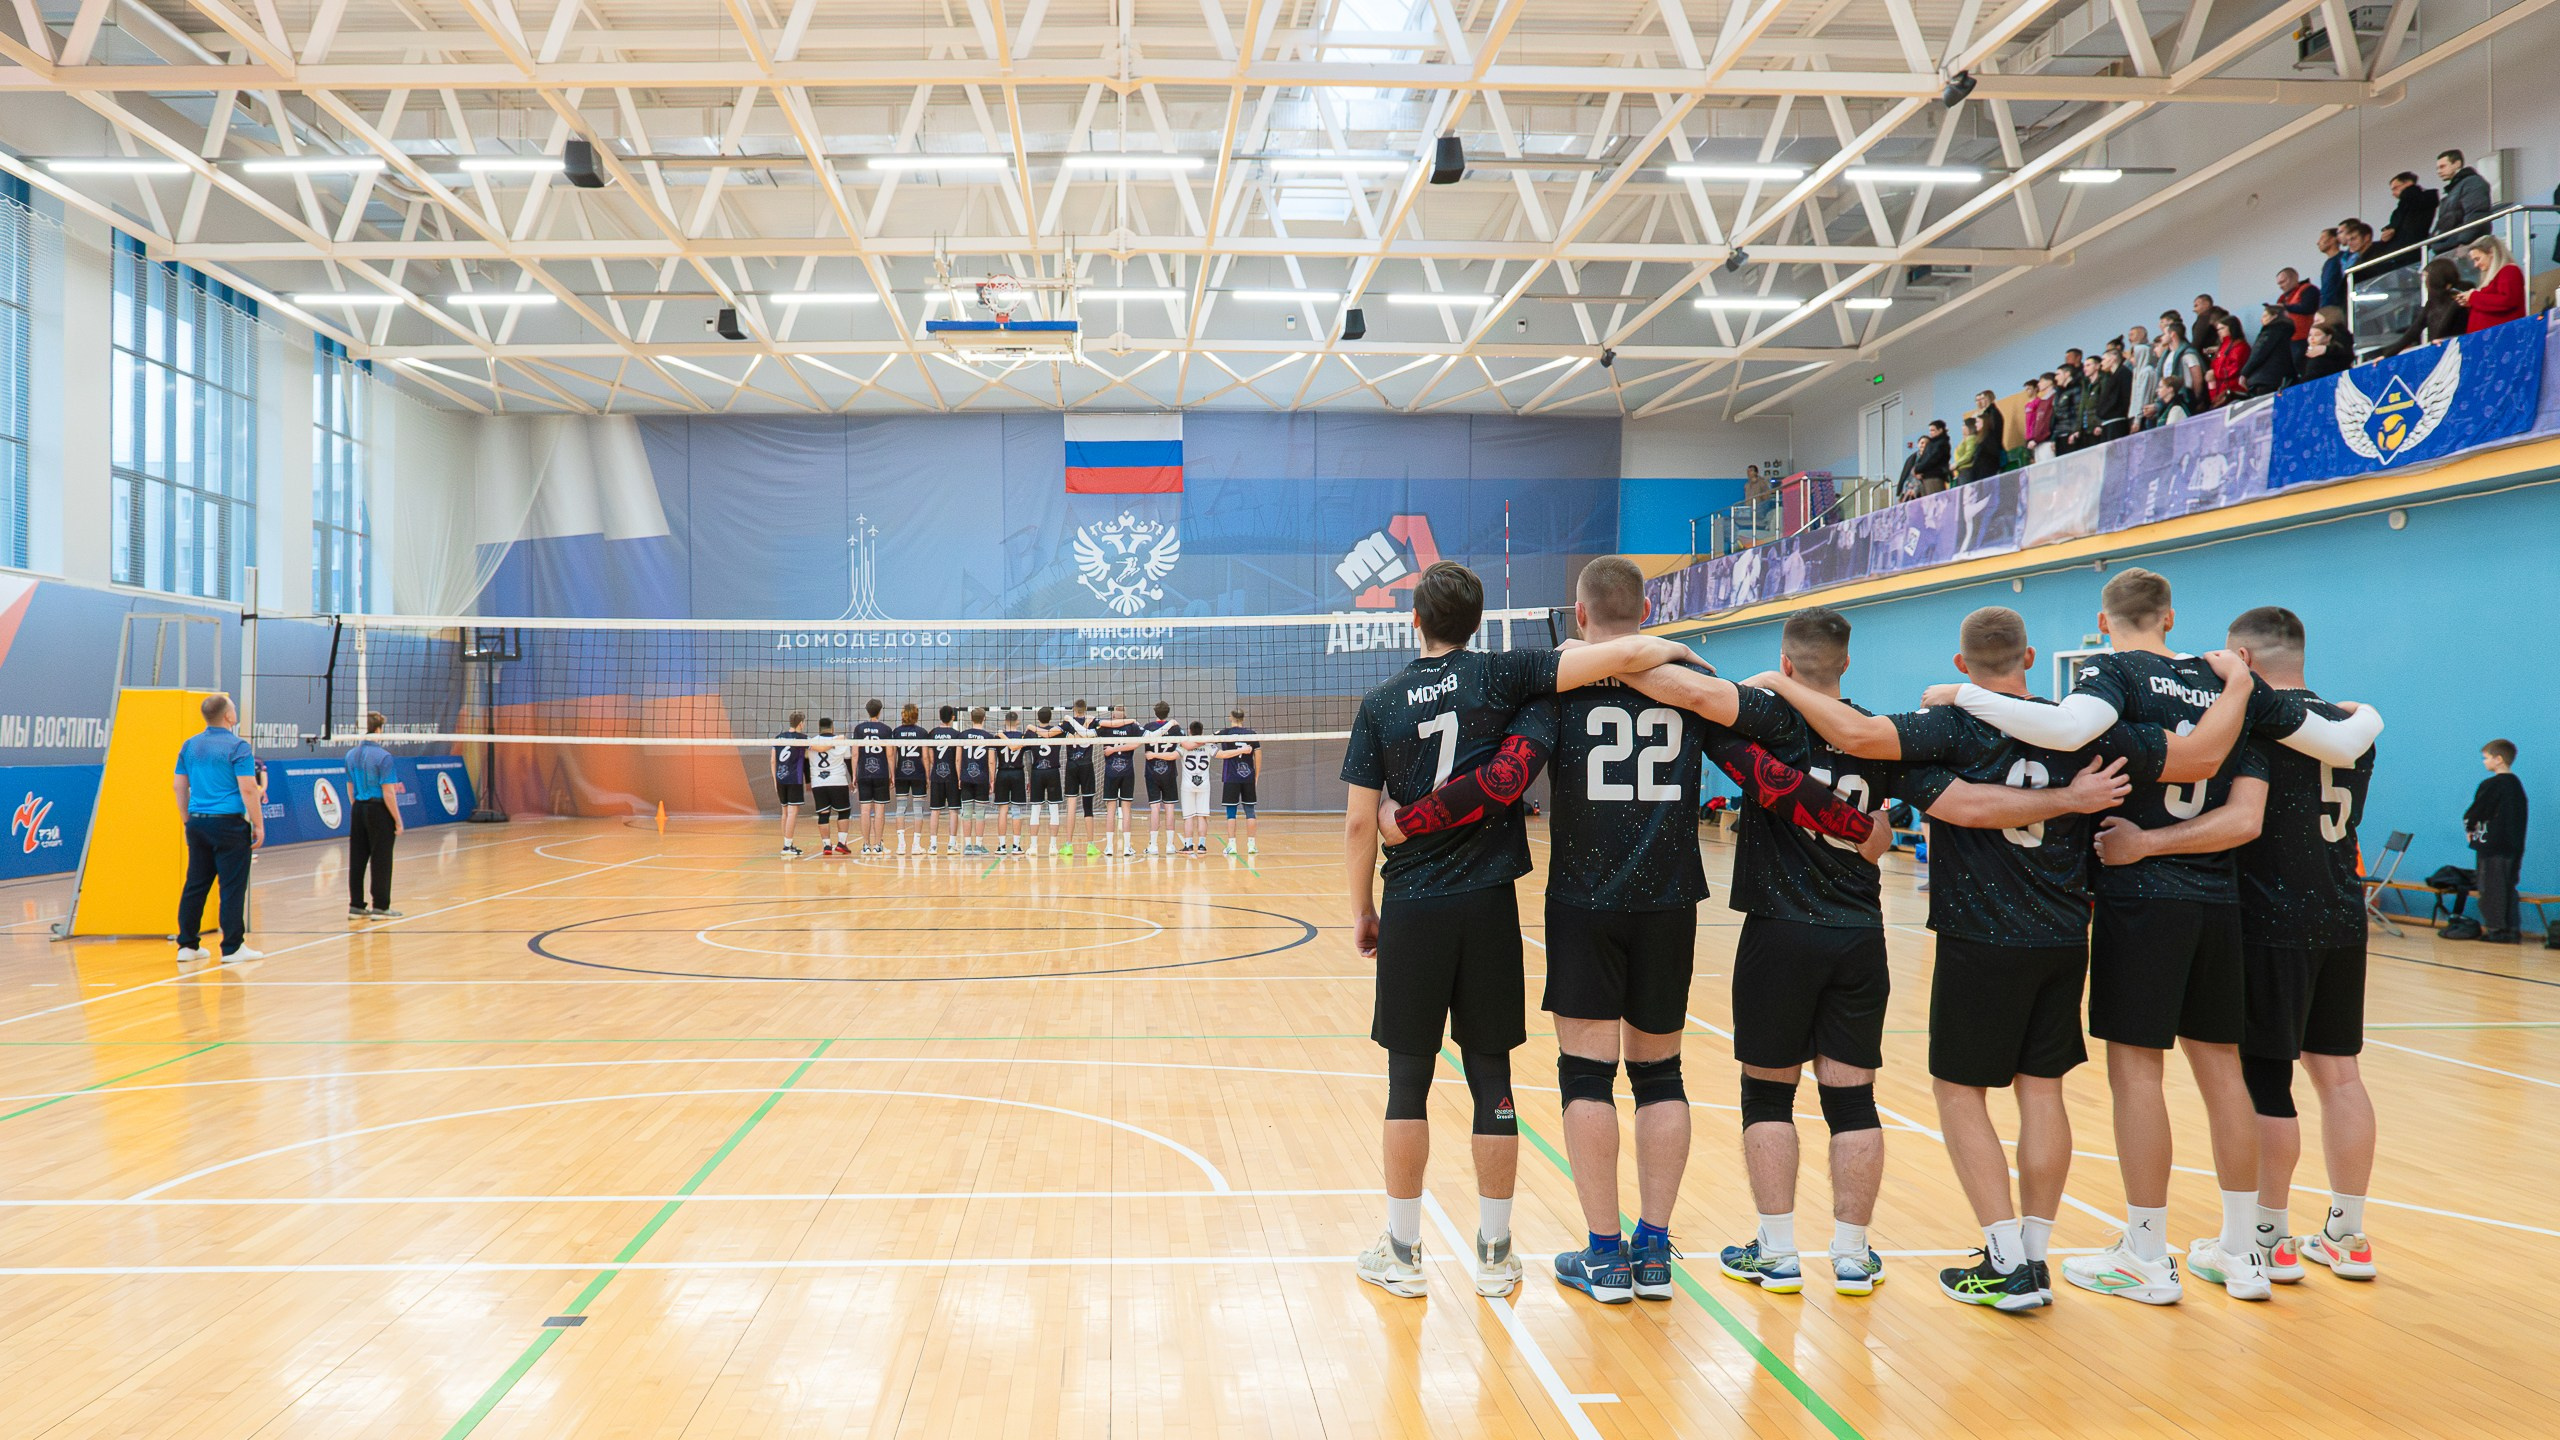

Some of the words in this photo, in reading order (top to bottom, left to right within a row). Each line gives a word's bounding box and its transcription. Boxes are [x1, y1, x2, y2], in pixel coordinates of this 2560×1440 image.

[776, 631, 953, 651] ДОМОДЕДОВО
[1077, 627, 1174, 639] МИНСПОРТ
[1089, 645, 1164, 660] РОССИИ
[0, 715, 30, 748] МЫ
[33, 715, 110, 748] ВОСПИТЫ
[863, 735, 883, 753] 18
[1417, 711, 1459, 791] 7
[1587, 705, 1684, 801] 22
[779, 745, 791, 762] 6
[818, 752, 830, 768] 8
[1184, 755, 1209, 771] 55
[2320, 760, 2353, 842] 5
